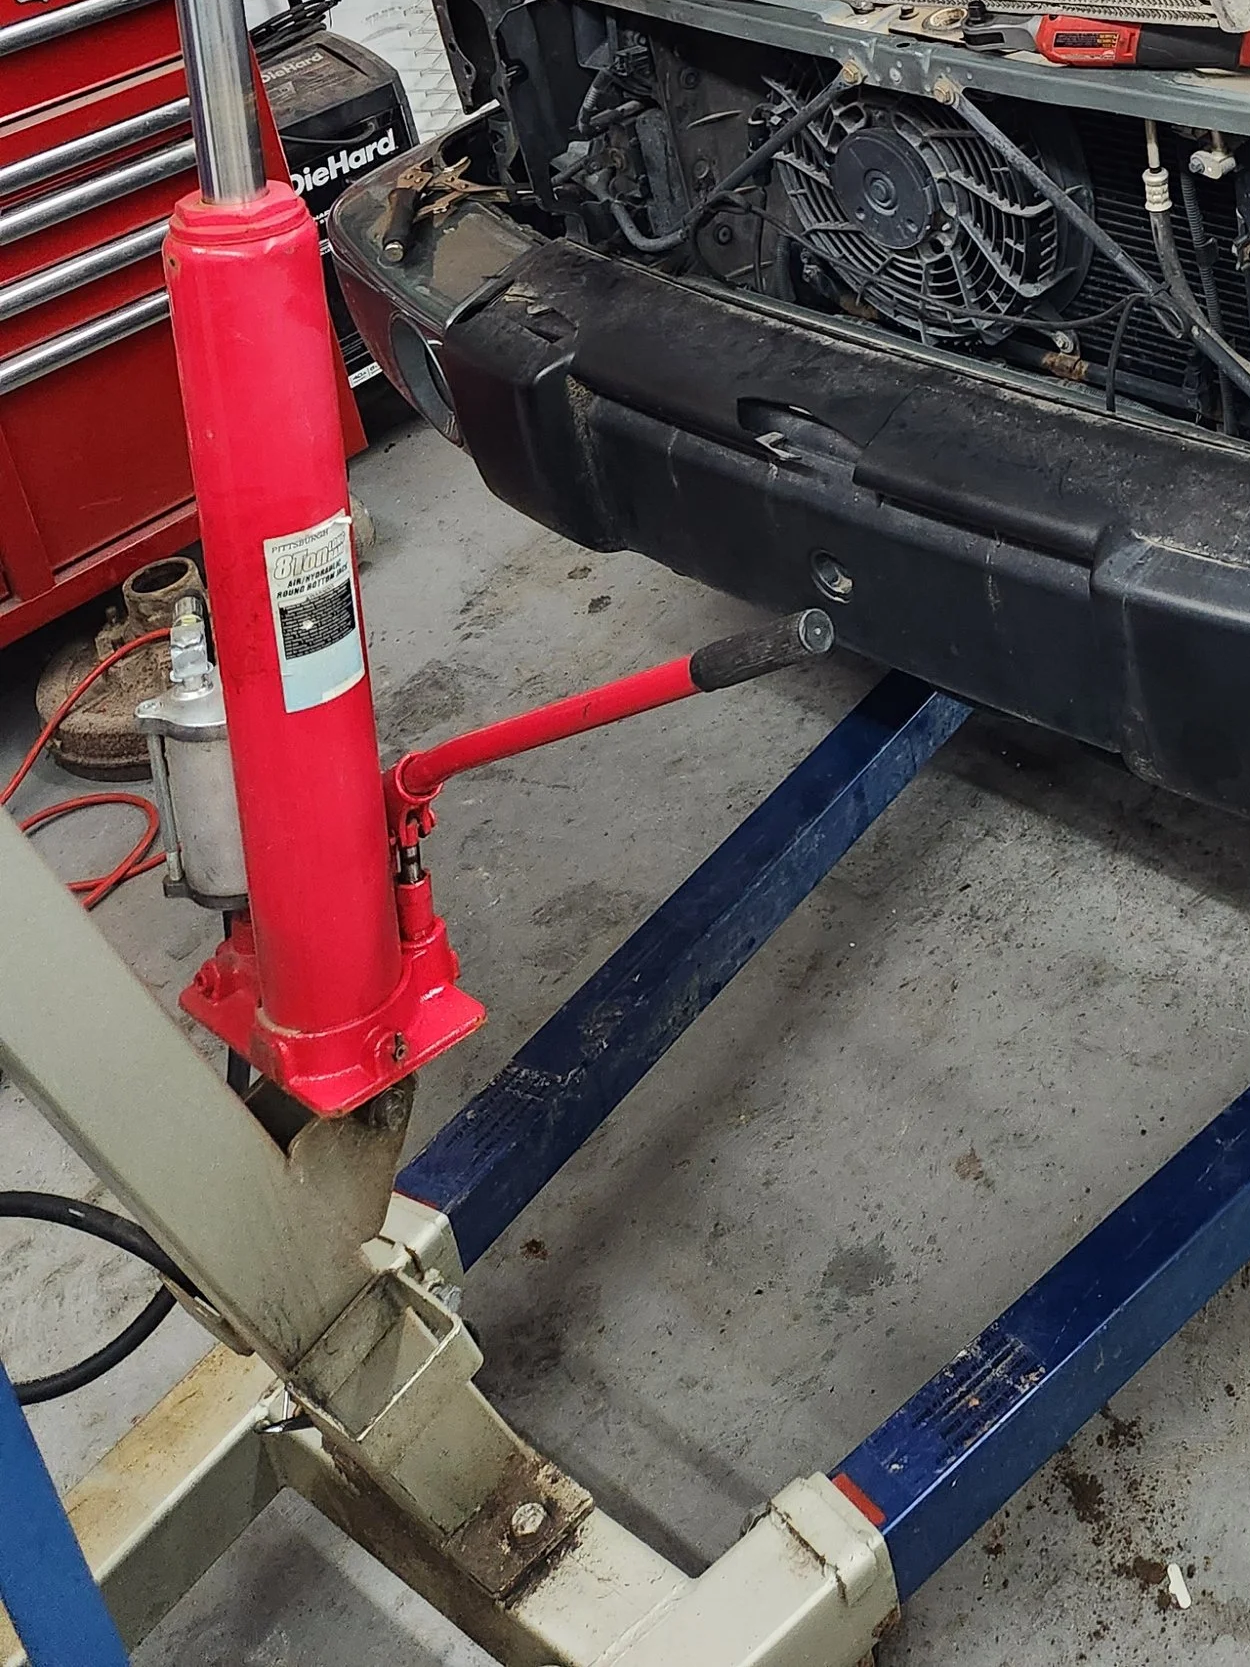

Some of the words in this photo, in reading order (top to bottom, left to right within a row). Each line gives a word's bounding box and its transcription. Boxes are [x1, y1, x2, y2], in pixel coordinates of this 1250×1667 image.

[262, 52, 324, 84] DieHard
[290, 128, 396, 196] DieHard
[276, 584, 305, 599] ROUND
[306, 571, 335, 590] BOTTOM
